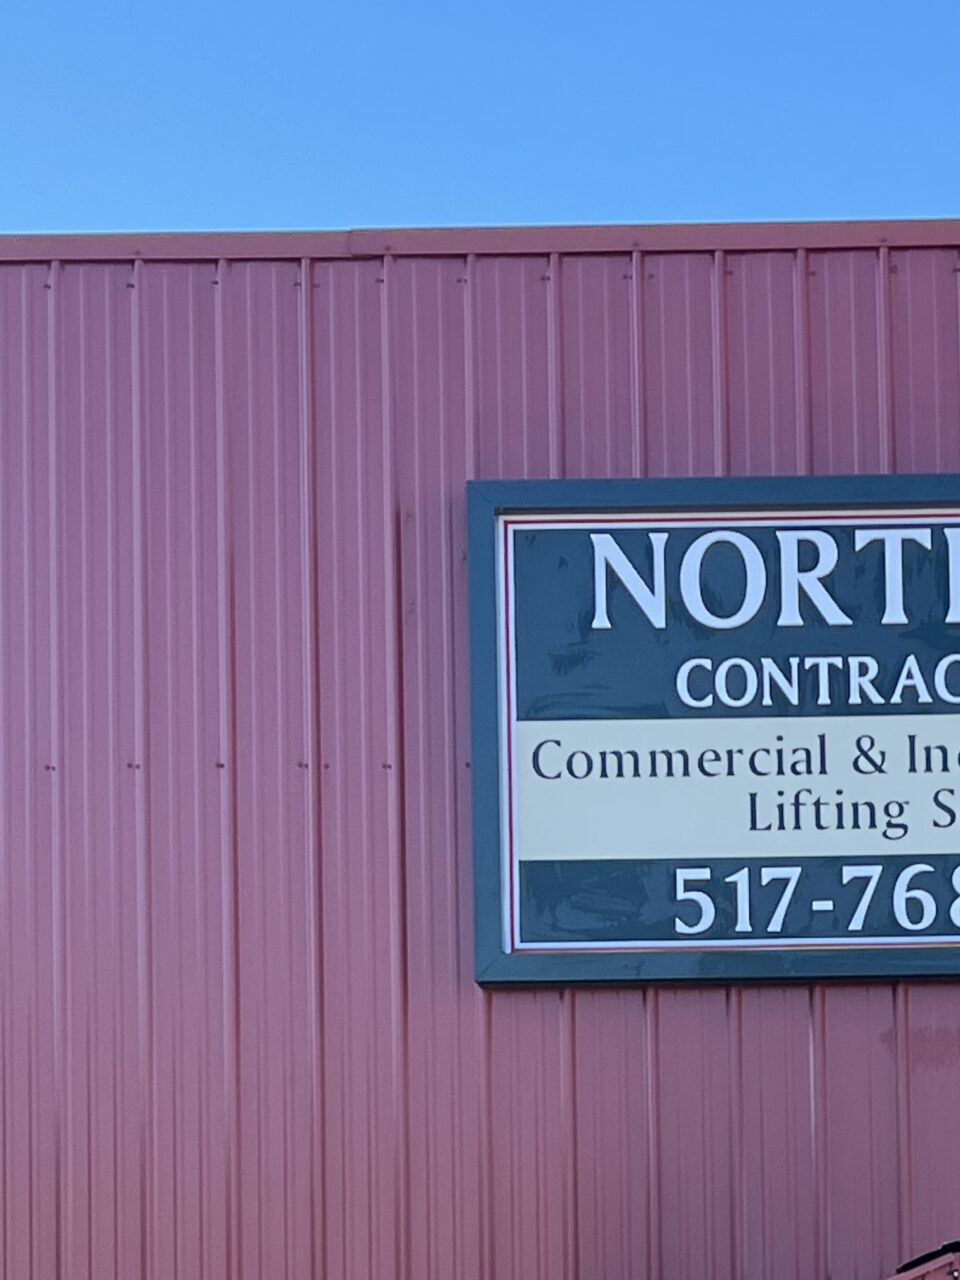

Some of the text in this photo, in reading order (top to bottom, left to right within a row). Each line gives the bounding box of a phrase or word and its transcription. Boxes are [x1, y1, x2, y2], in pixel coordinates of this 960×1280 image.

[531, 732, 829, 780] Commercial
[851, 733, 889, 776] &
[747, 787, 909, 841] Lifting
